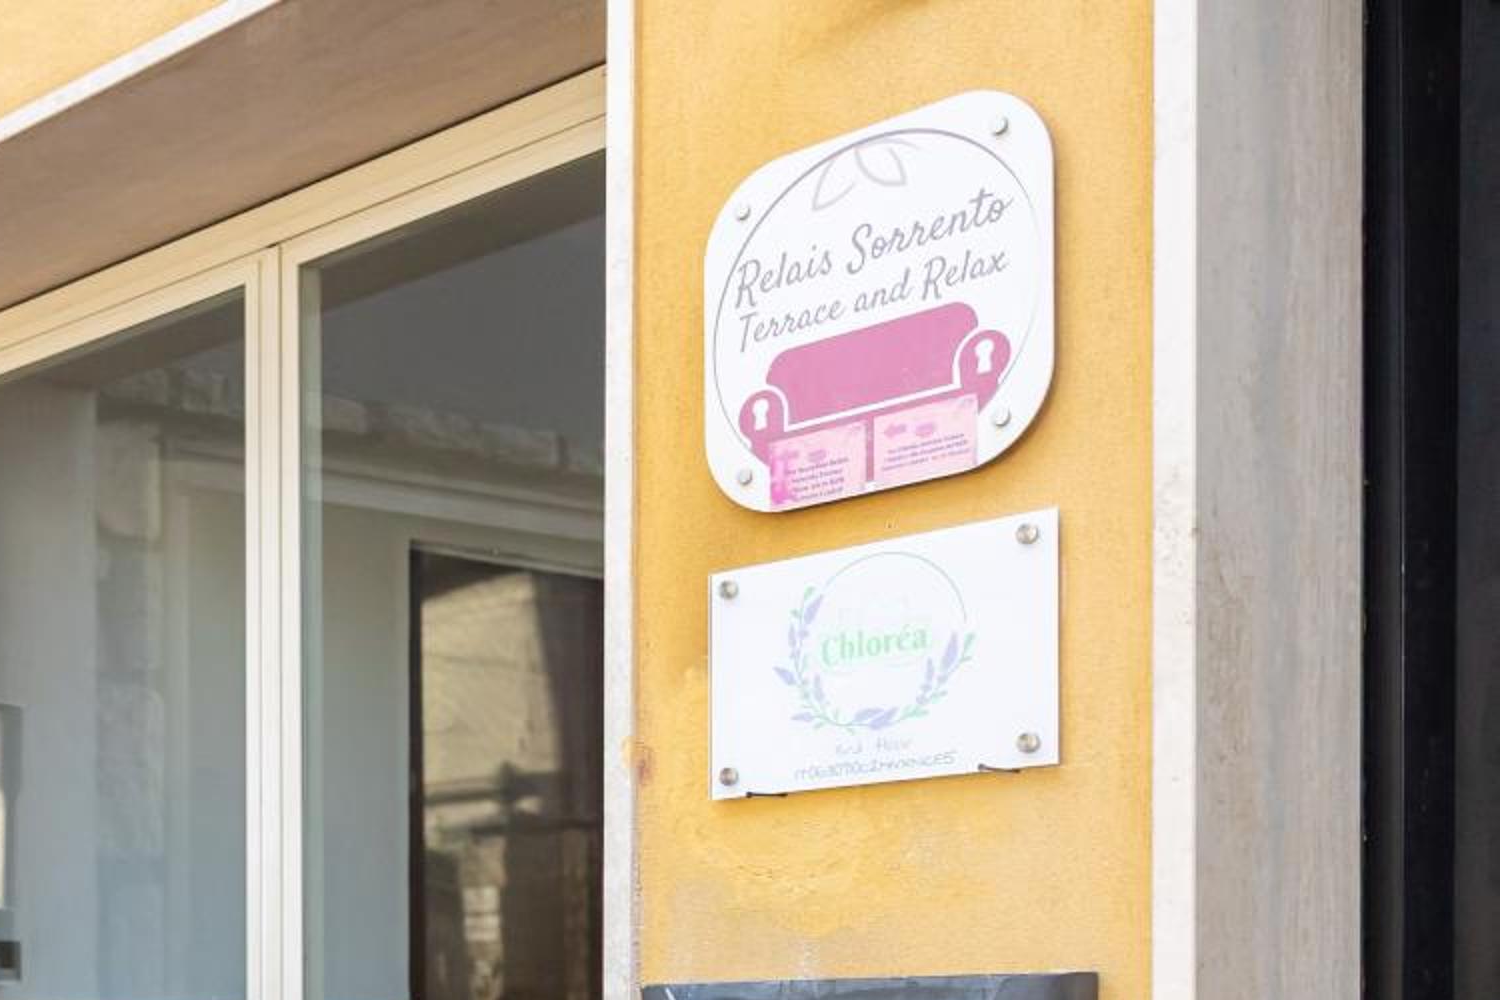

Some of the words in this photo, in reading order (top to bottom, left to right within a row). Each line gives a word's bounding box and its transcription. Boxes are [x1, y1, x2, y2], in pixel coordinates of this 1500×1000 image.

[734, 245, 833, 310] Relais
[846, 187, 1014, 275] Sorrento
[739, 299, 844, 353] Terrace
[853, 266, 914, 313] and
[921, 249, 1008, 301] Relax
